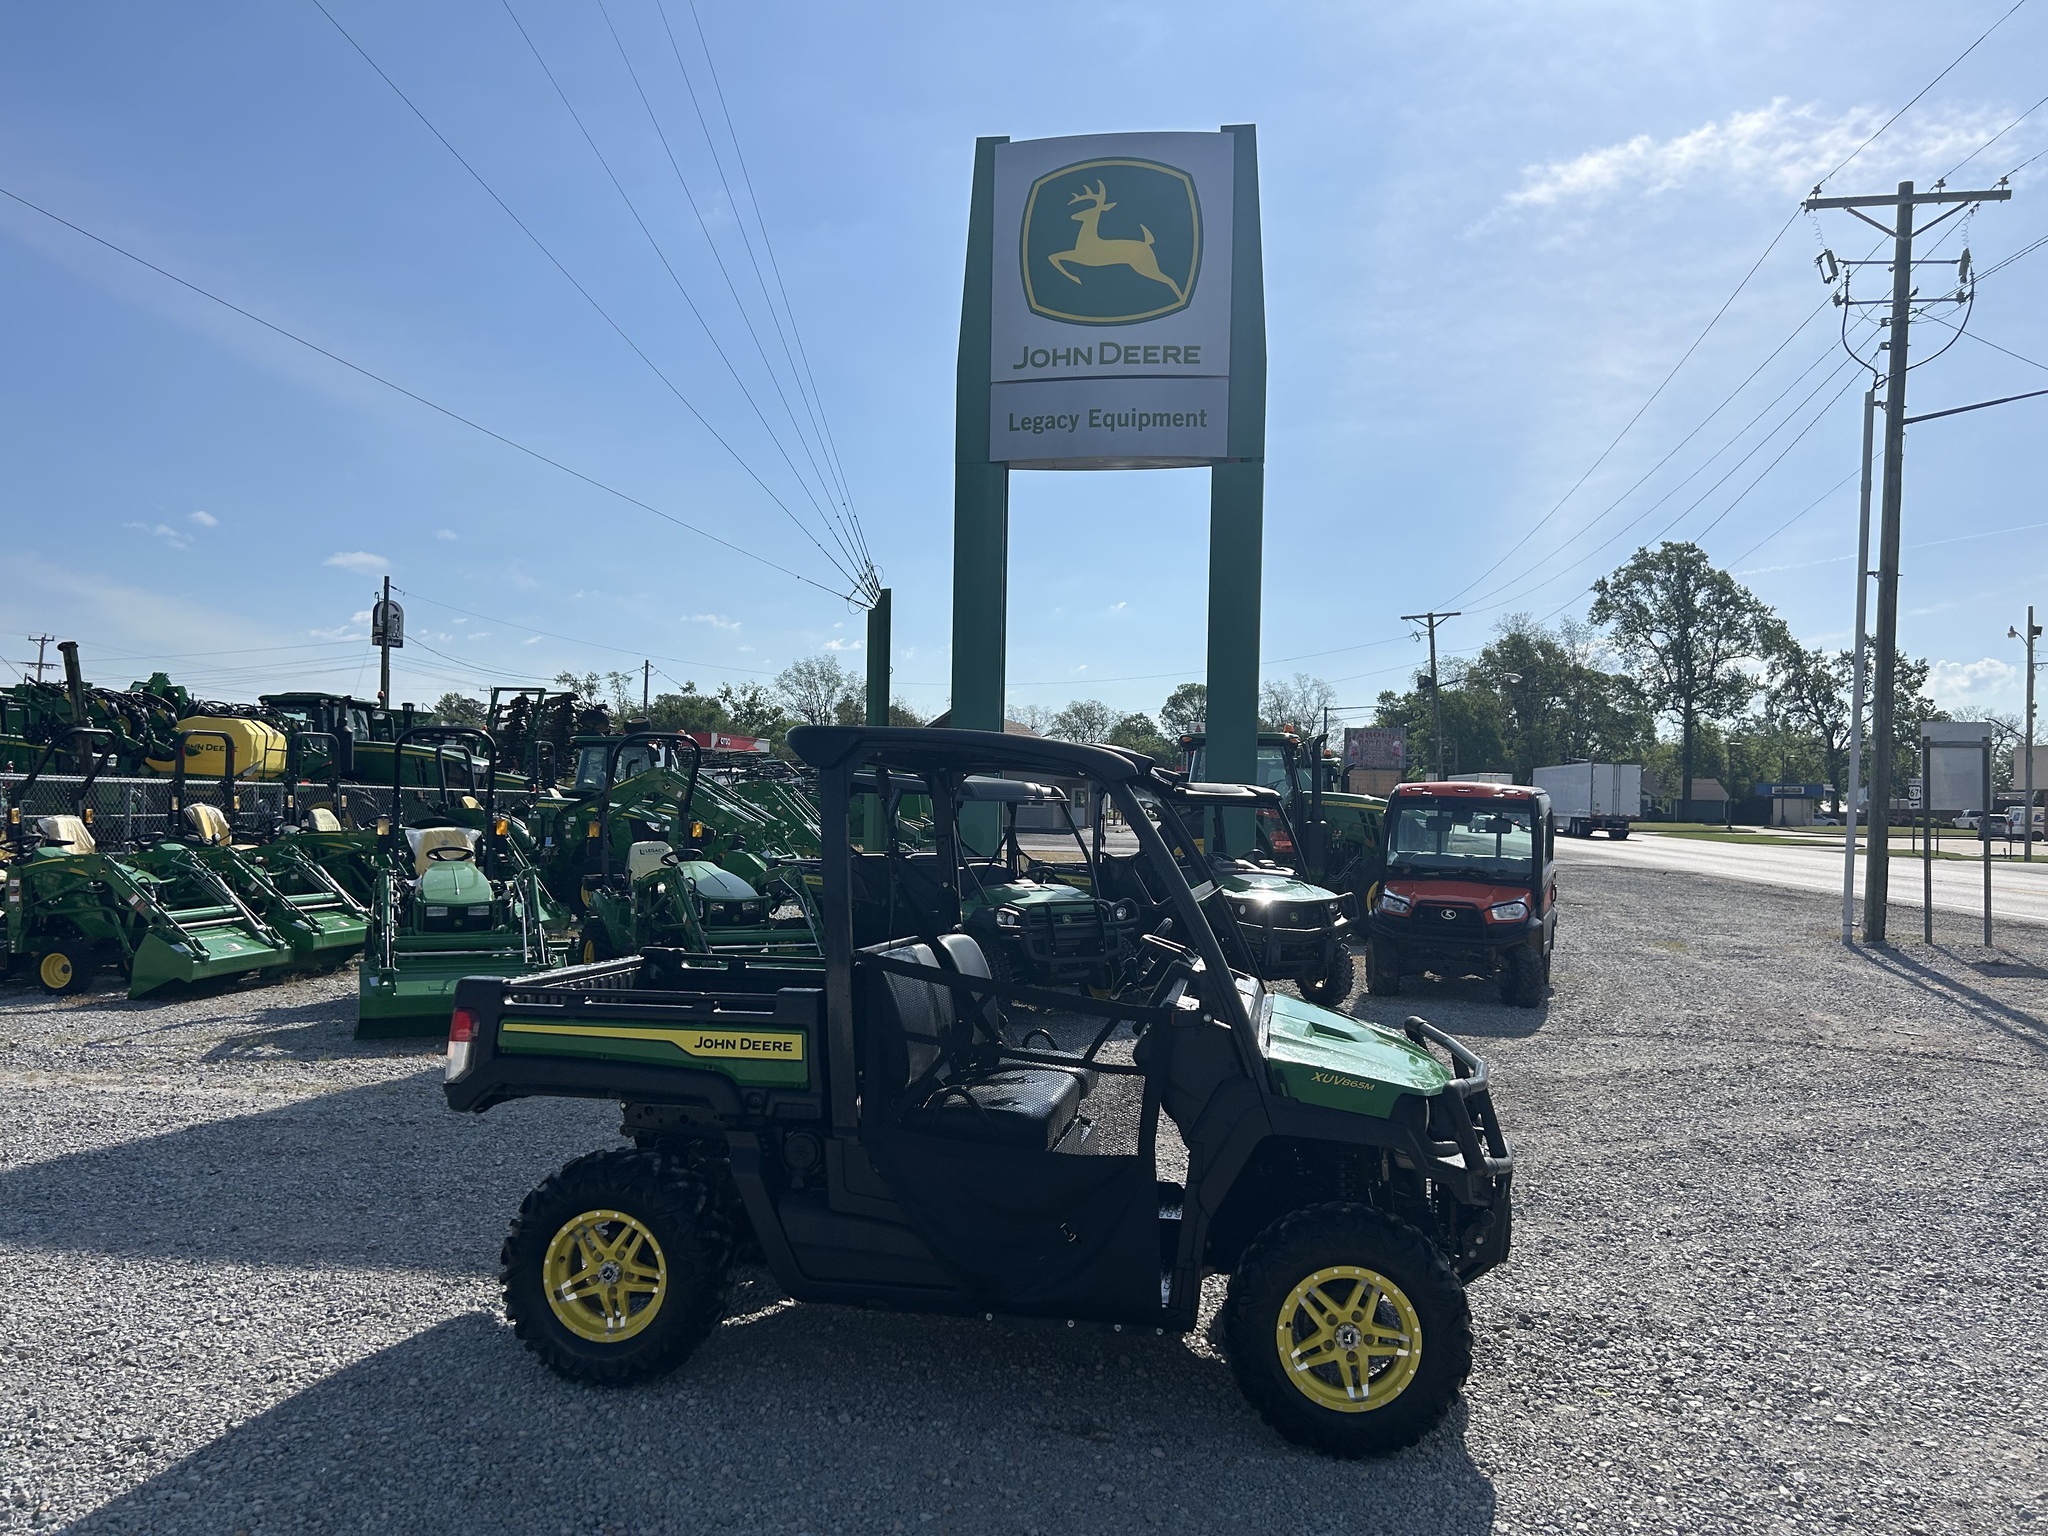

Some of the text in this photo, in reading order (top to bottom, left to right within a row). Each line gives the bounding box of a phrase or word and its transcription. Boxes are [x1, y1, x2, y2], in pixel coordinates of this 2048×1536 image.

[1013, 341, 1202, 370] JOHN DEERE
[1008, 408, 1208, 435] Legacy Equipment
[1910, 789, 1919, 797] 67
[694, 1036, 793, 1052] JOHN DEERE
[1310, 1071, 1375, 1091] XUV865M
